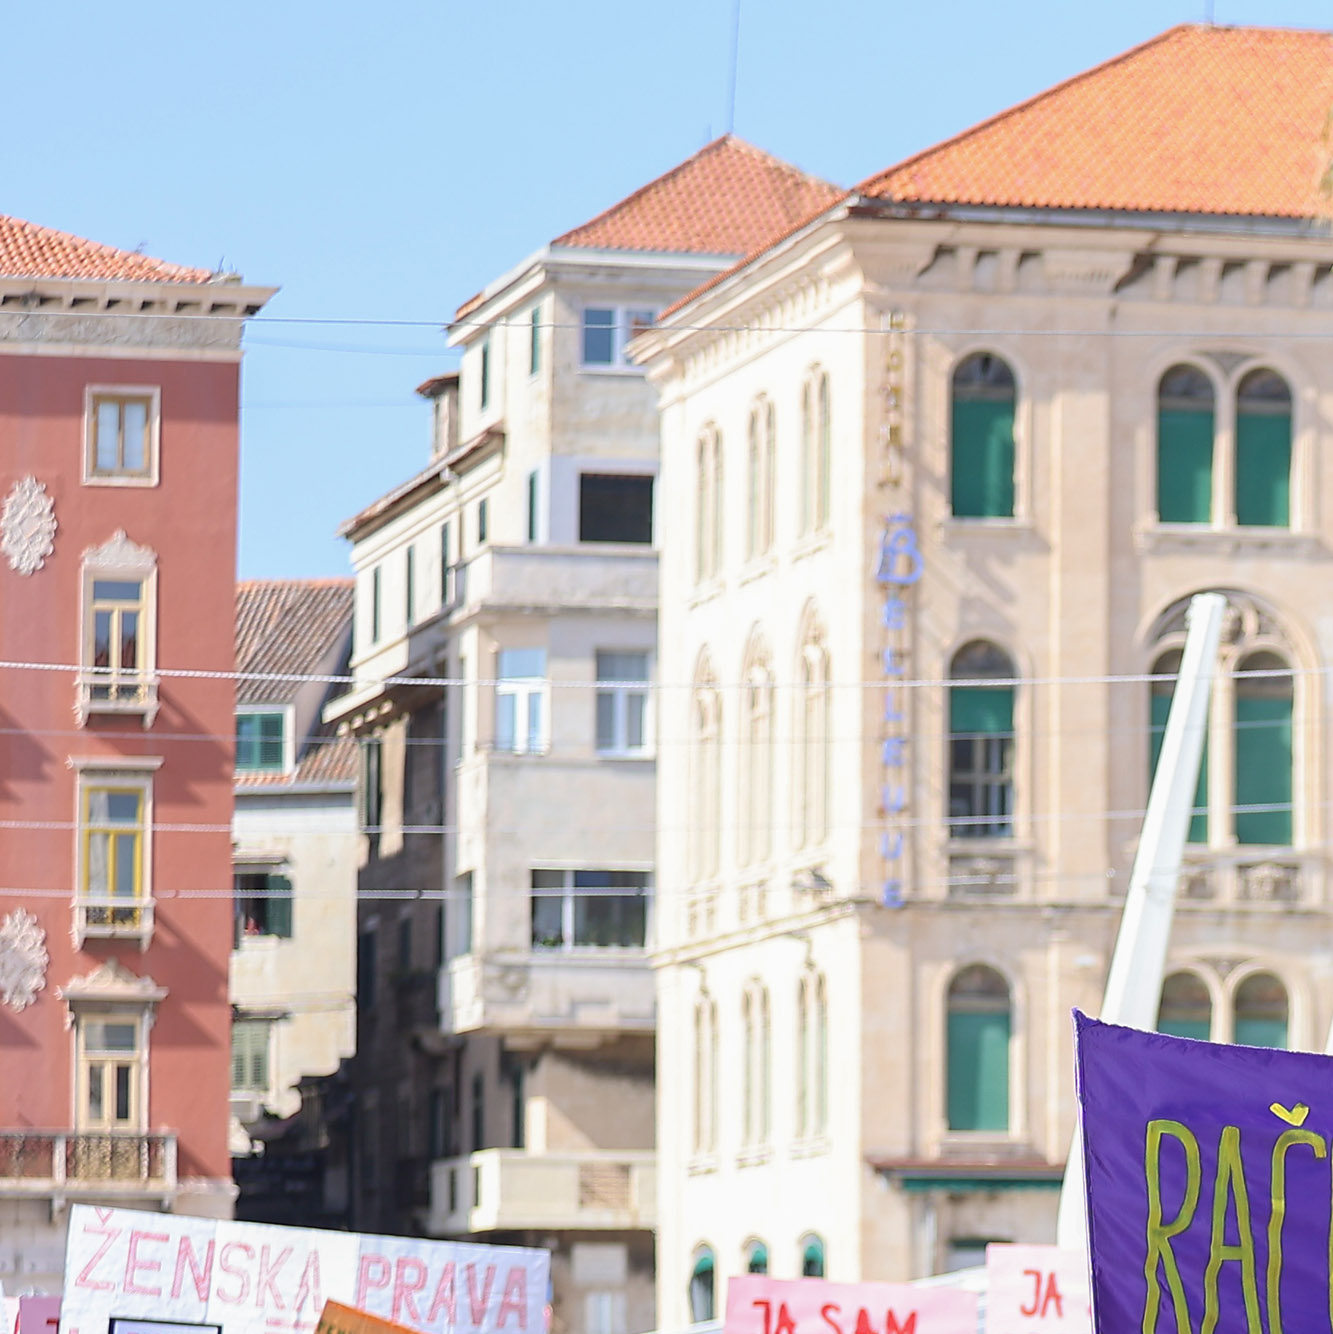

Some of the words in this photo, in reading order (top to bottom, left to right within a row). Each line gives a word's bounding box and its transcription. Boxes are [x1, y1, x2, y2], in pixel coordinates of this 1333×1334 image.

[75, 1207, 323, 1315] ŽENSKA
[357, 1254, 528, 1331] PRAVA
[1020, 1269, 1064, 1319] JA
